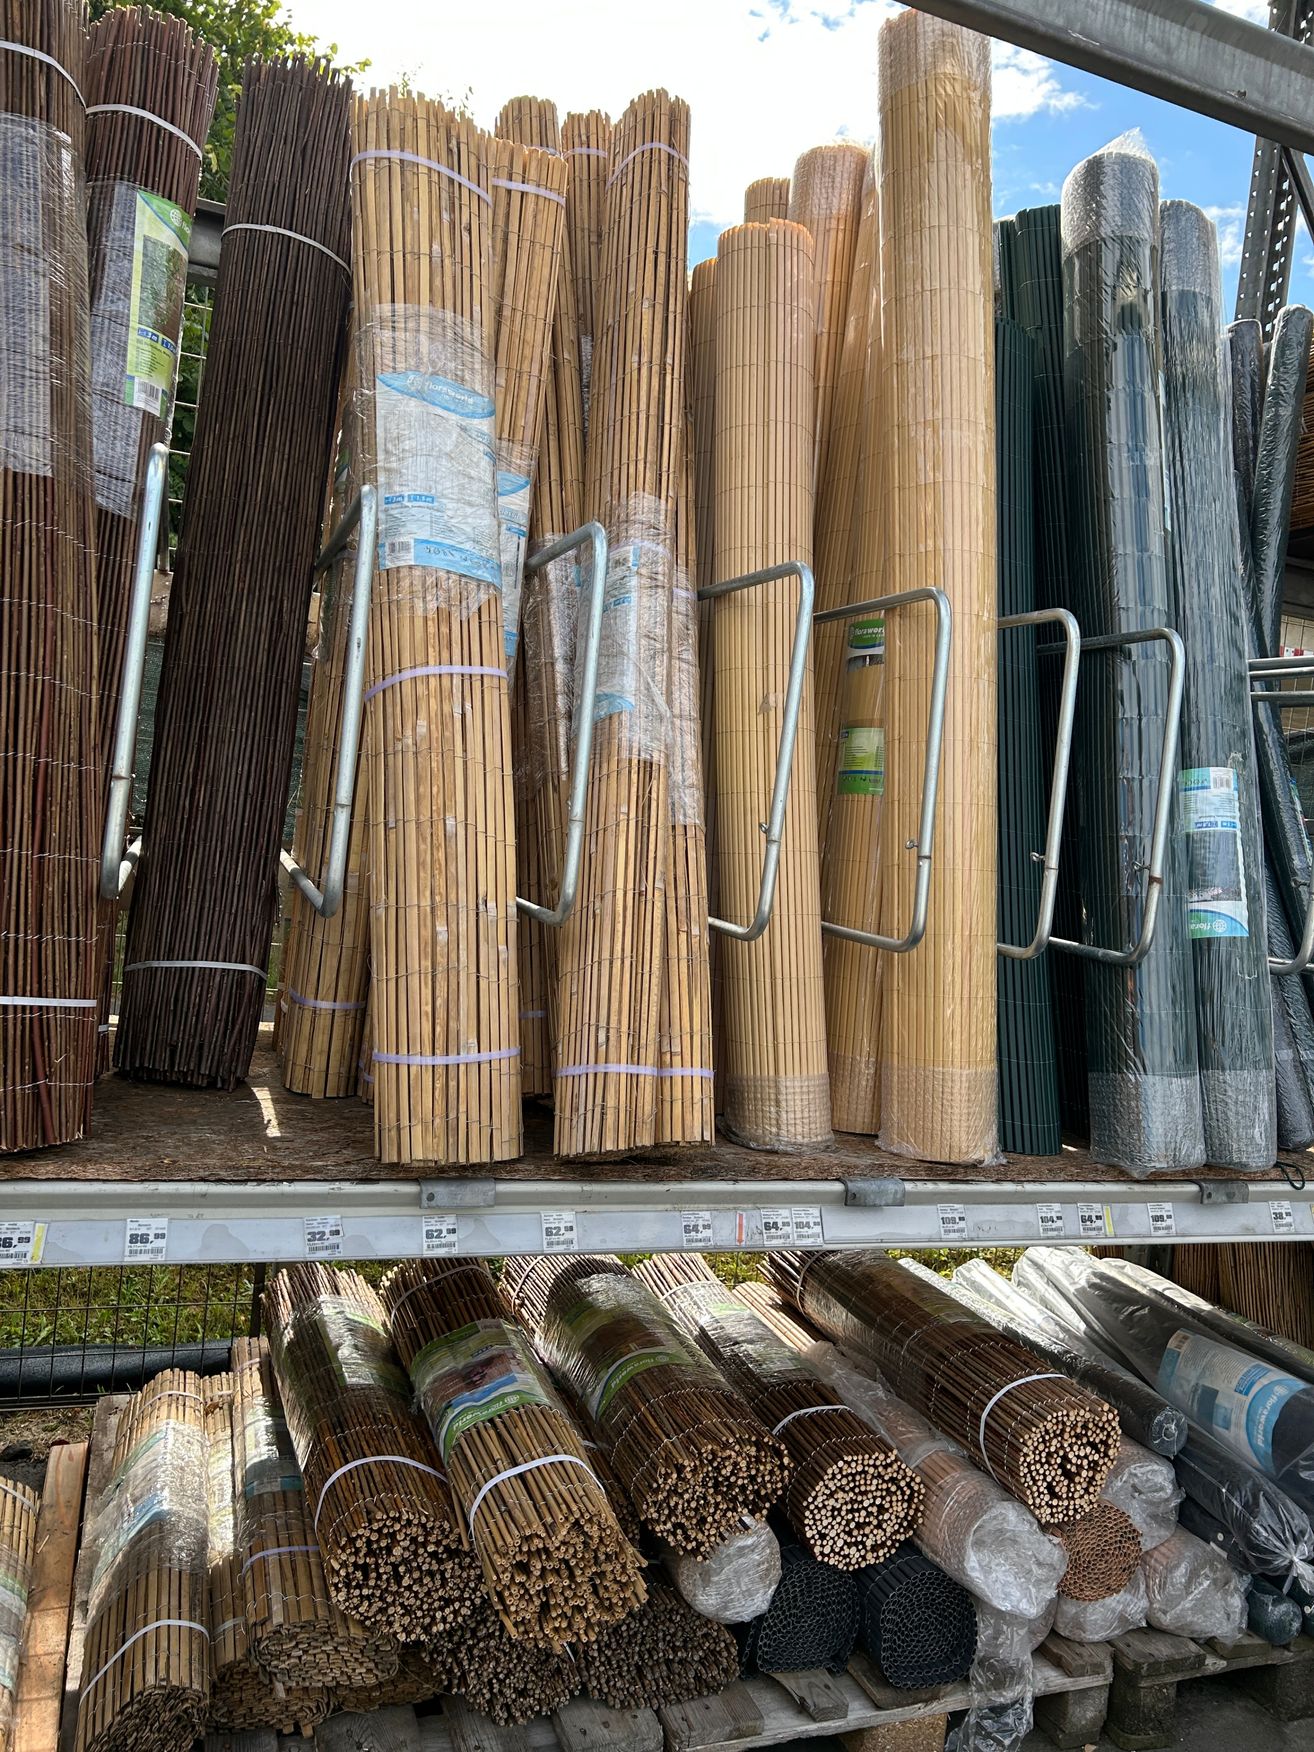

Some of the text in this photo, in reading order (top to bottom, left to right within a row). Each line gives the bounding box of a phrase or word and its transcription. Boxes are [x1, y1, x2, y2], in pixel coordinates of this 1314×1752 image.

[307, 1229, 340, 1242] 32,99
[425, 1227, 457, 1240] 62,99
[545, 1225, 574, 1237] 62,99
[129, 1232, 166, 1245] 86,99
[1256, 1393, 1280, 1448] floraworld
